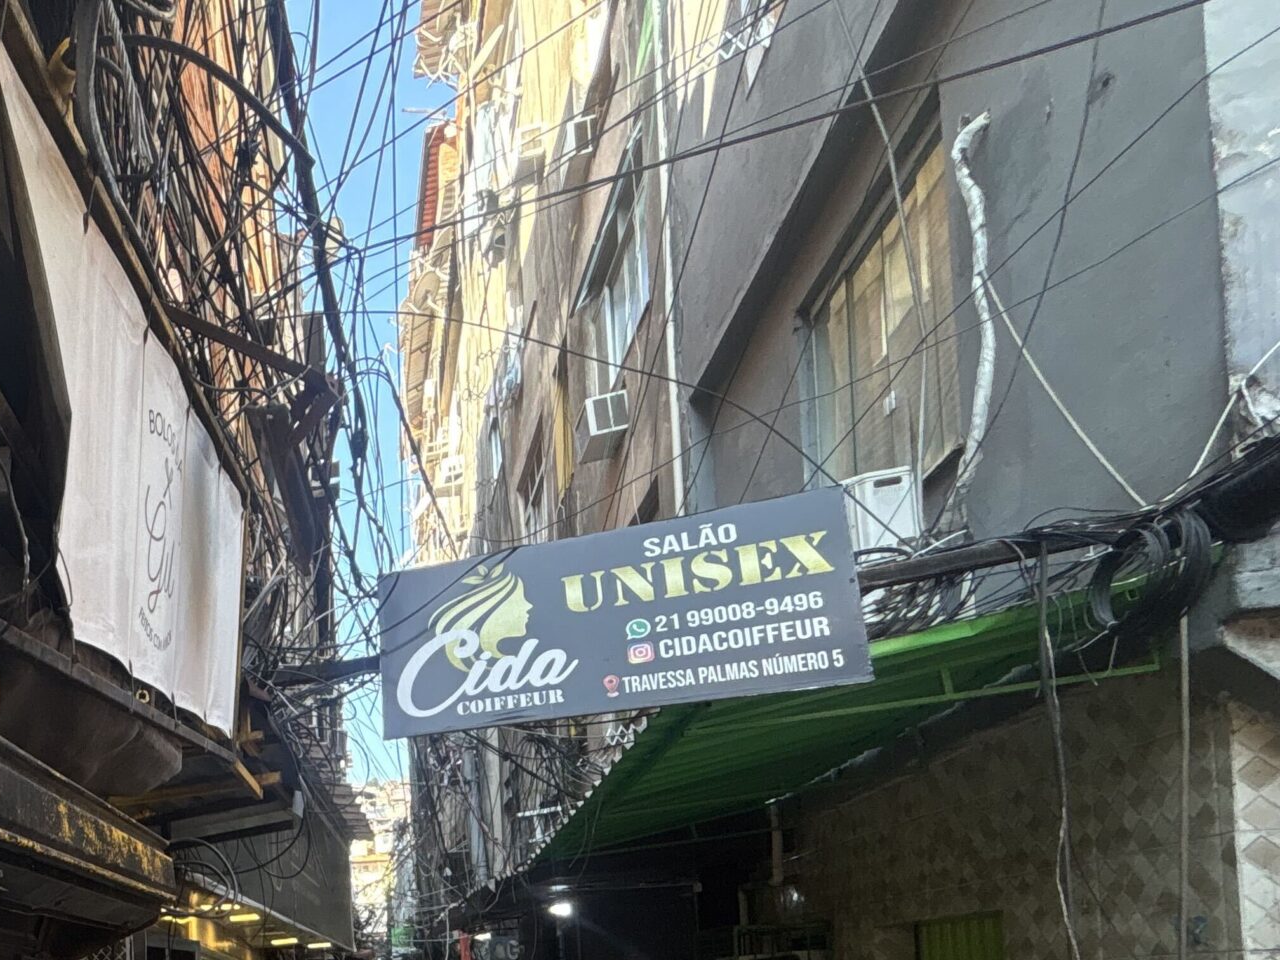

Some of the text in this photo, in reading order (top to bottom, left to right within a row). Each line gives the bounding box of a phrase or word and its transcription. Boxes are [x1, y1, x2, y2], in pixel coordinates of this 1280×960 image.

[643, 523, 738, 557] SALÃO
[561, 531, 835, 613] UNISEX
[655, 590, 824, 632] 21 99008-9496
[659, 616, 831, 659] CIDACOIFFEUR
[397, 628, 579, 718] Cida
[622, 648, 845, 695] TRAVESSA PALMAS NÚMERO 5
[456, 689, 565, 716] COIFFEUR
